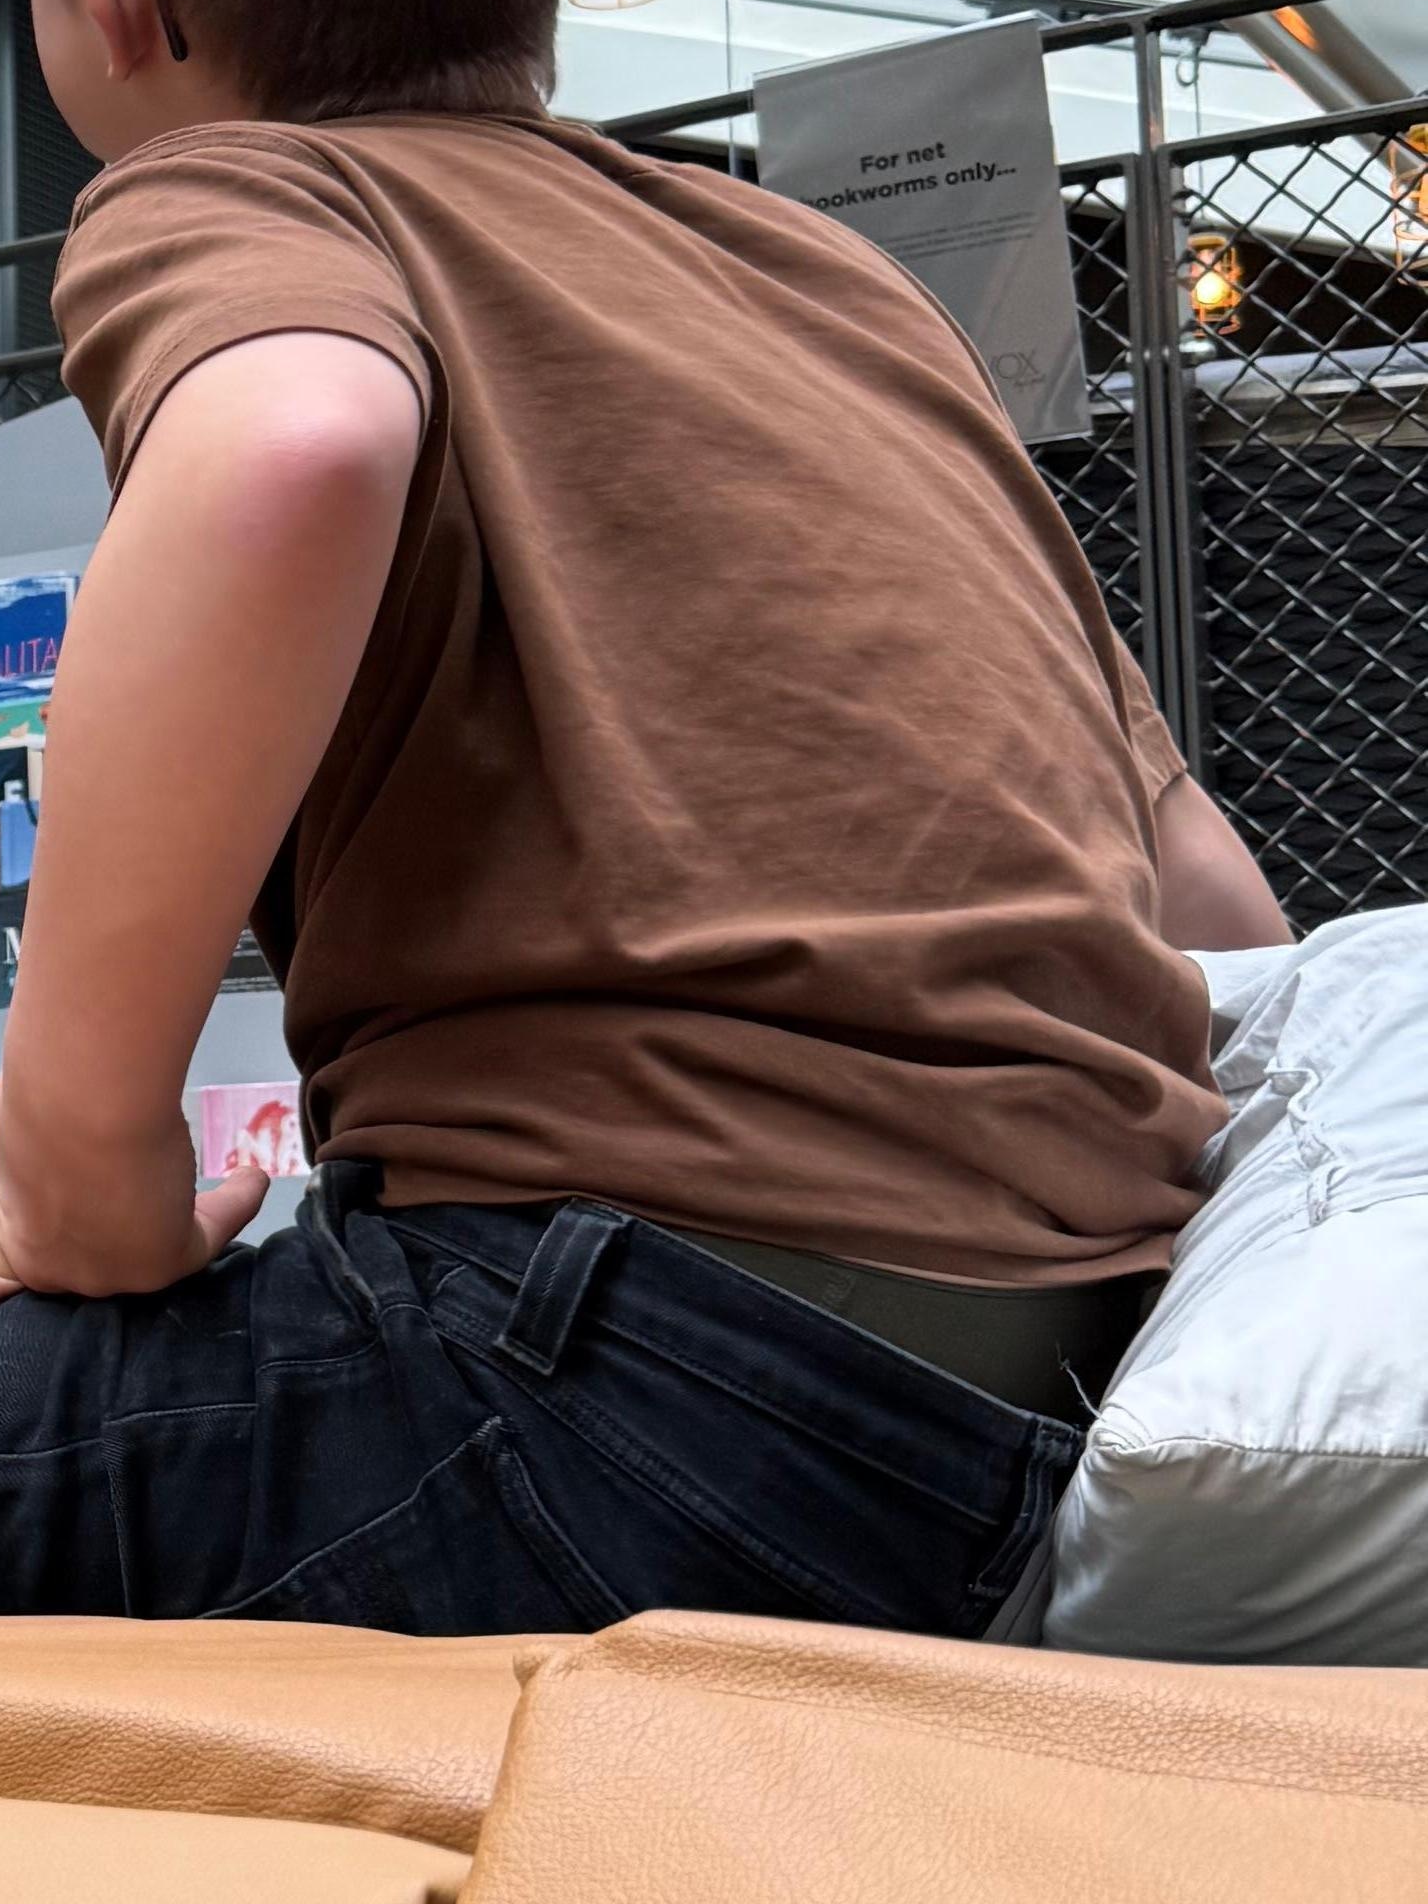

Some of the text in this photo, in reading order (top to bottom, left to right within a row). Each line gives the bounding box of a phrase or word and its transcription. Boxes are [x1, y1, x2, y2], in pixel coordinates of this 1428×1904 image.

[860, 142, 946, 173] For net
[946, 162, 1017, 186] only...
